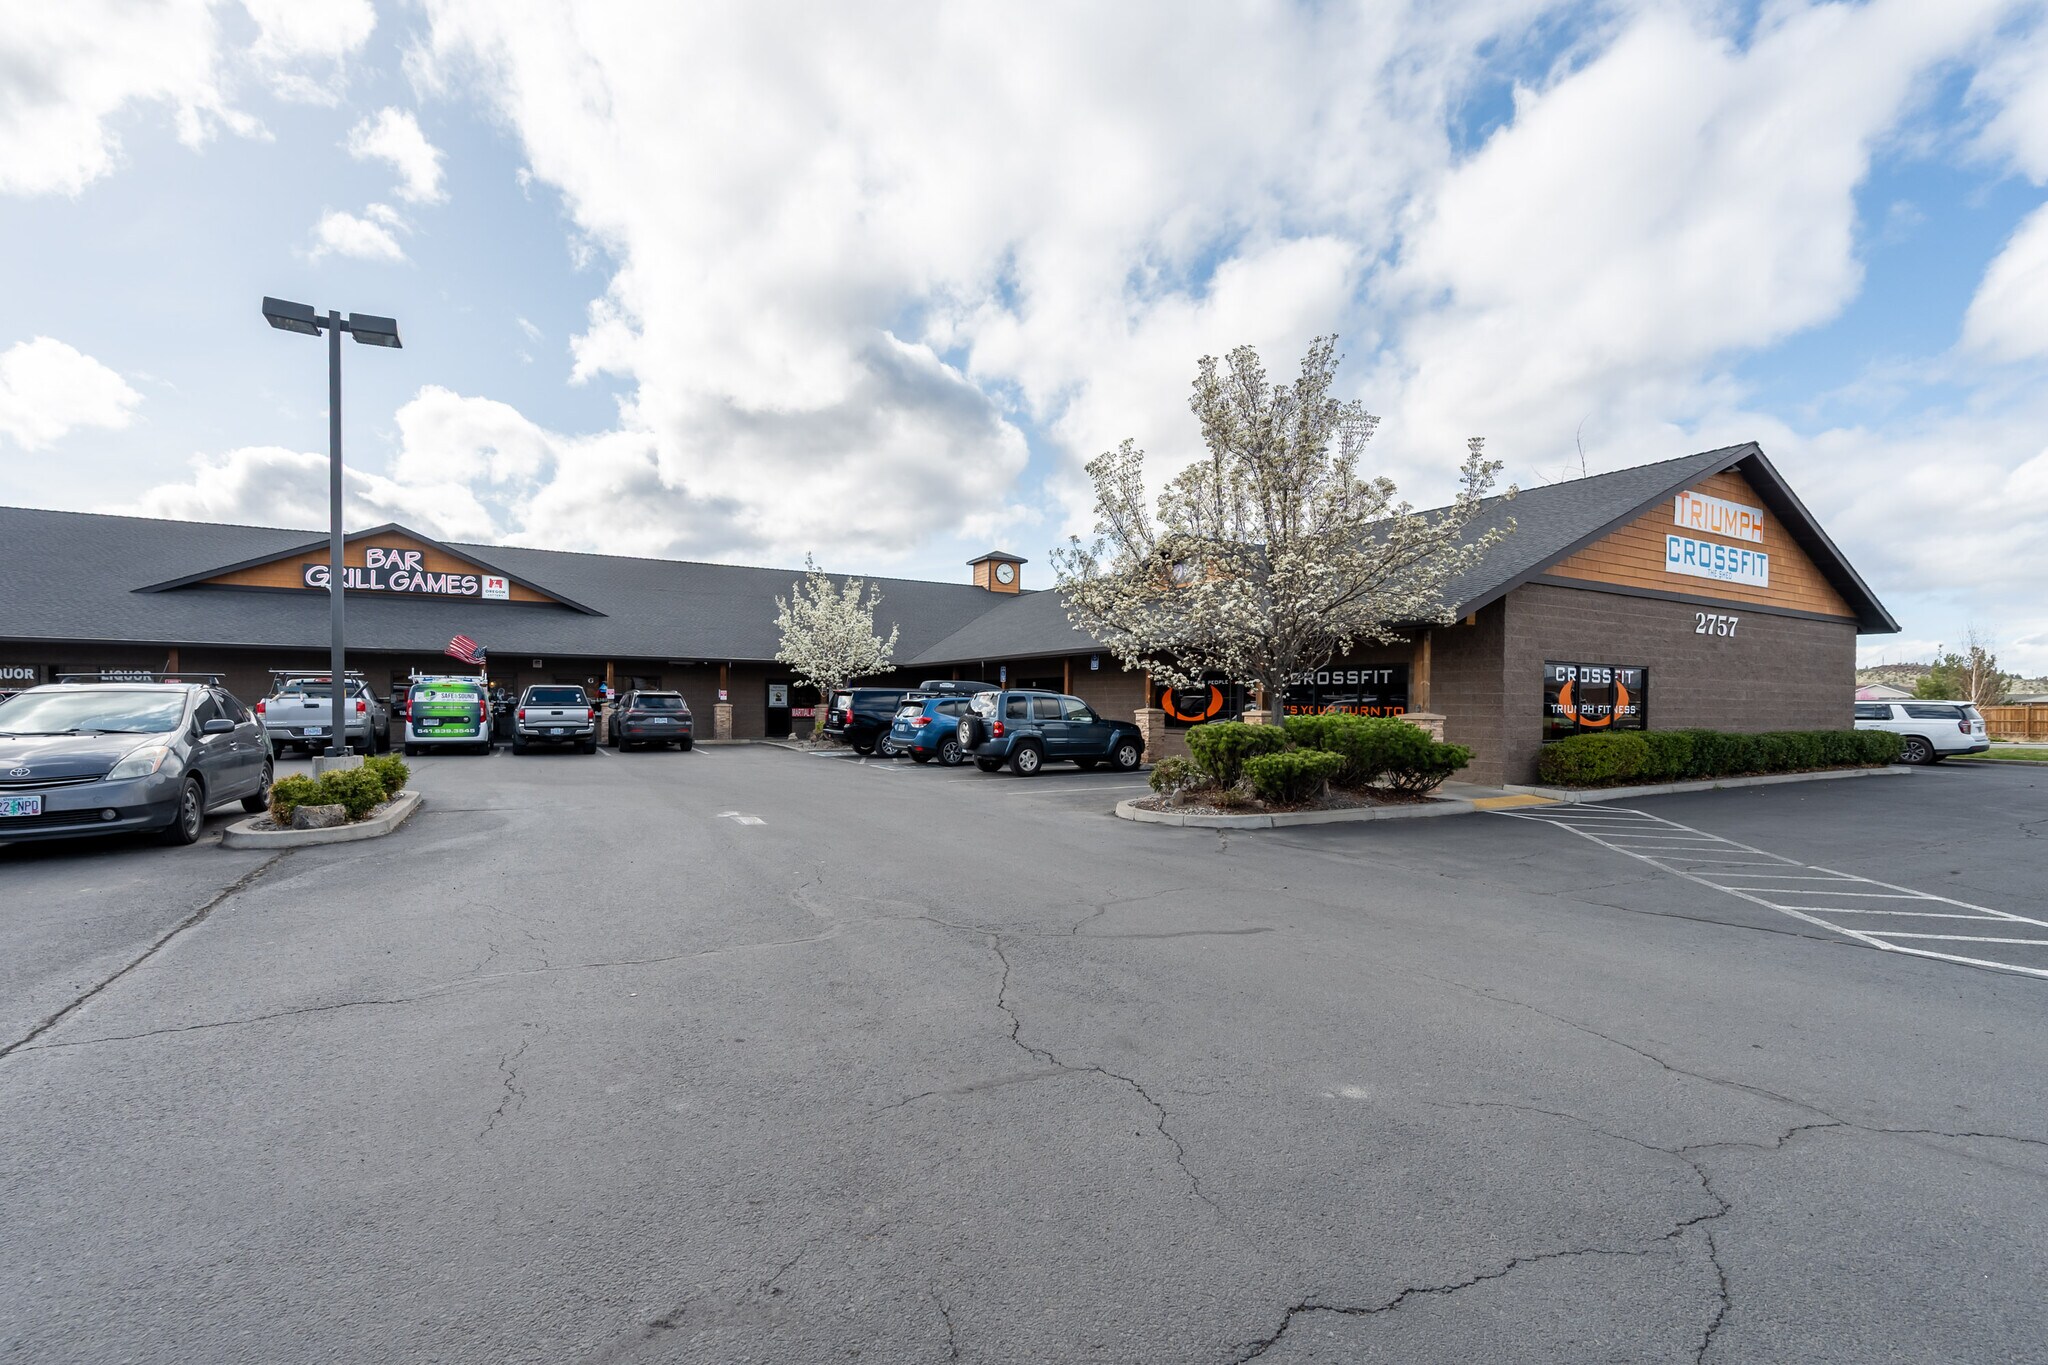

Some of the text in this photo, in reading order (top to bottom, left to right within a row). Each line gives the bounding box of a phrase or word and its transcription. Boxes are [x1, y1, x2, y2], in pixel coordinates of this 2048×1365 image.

[1676, 491, 1763, 541] TRIUMPH
[366, 548, 423, 572] BAR
[1668, 536, 1767, 577] CROSSFIT
[305, 565, 478, 595] GILL GAMES
[1695, 612, 1739, 638] 2757
[101, 669, 152, 681] LIQUOR
[1290, 669, 1393, 685] CROSSFIT
[1555, 666, 1634, 684] CROSSFIT
[1340, 706, 1380, 716] TURN
[1383, 706, 1405, 717] TO
